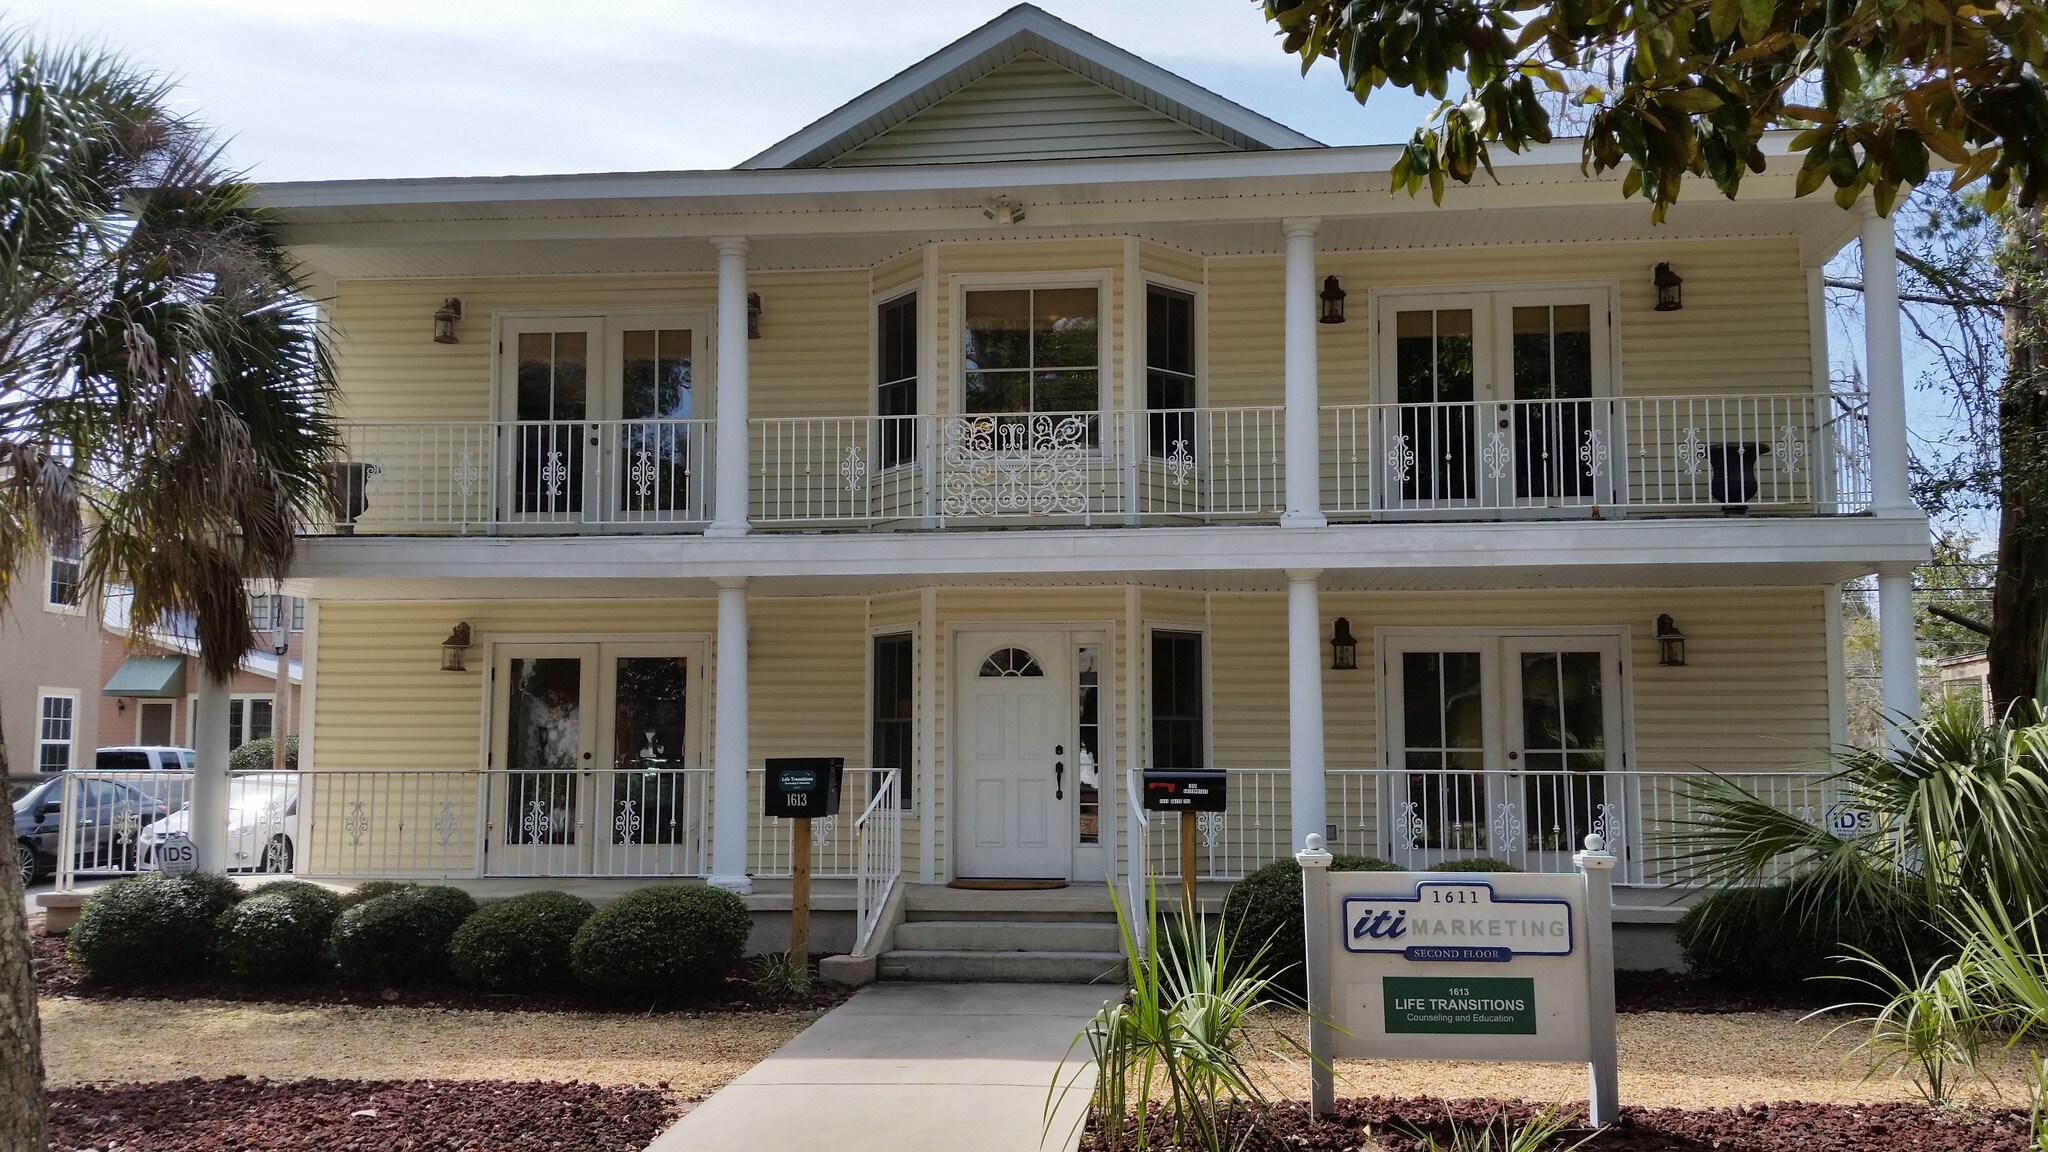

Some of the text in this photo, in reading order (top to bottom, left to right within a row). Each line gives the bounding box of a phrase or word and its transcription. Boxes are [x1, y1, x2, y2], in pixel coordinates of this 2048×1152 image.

[787, 793, 807, 806] 1613
[164, 846, 192, 861] IDS
[1433, 890, 1479, 904] 1611
[1353, 909, 1565, 939] iti MARKETING
[1414, 948, 1500, 959] SECOND FLOOR
[1448, 987, 1470, 996] 1613
[1395, 998, 1525, 1011] LIFE TRANSITIONS
[1406, 1013, 1514, 1024] Counseling and Education
